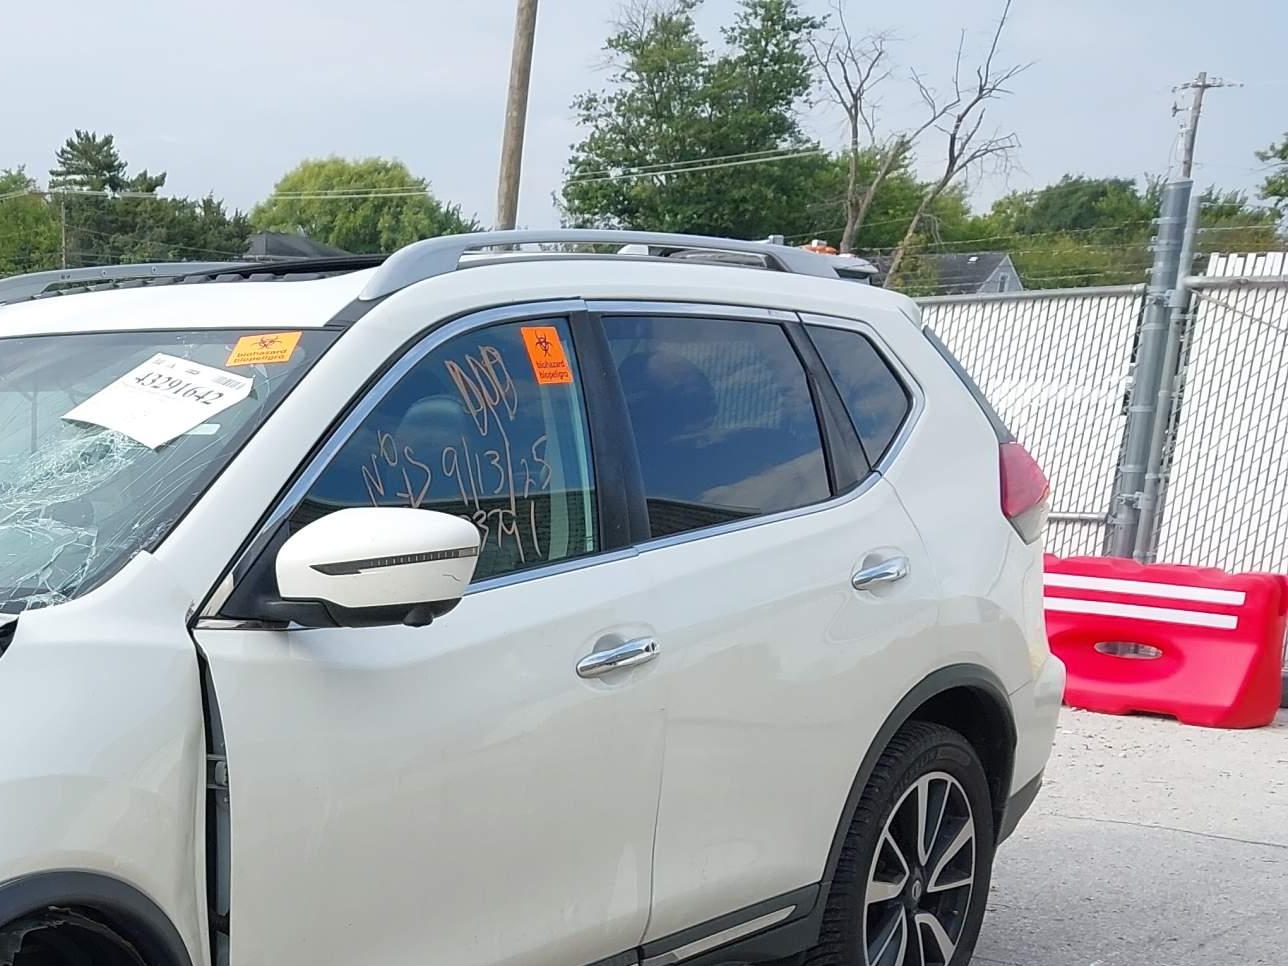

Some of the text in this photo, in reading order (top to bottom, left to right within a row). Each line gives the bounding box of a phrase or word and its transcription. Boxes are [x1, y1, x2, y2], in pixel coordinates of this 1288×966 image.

[236, 348, 288, 358] biohazard
[535, 360, 566, 369] biohazard
[134, 371, 225, 406] 43291642
